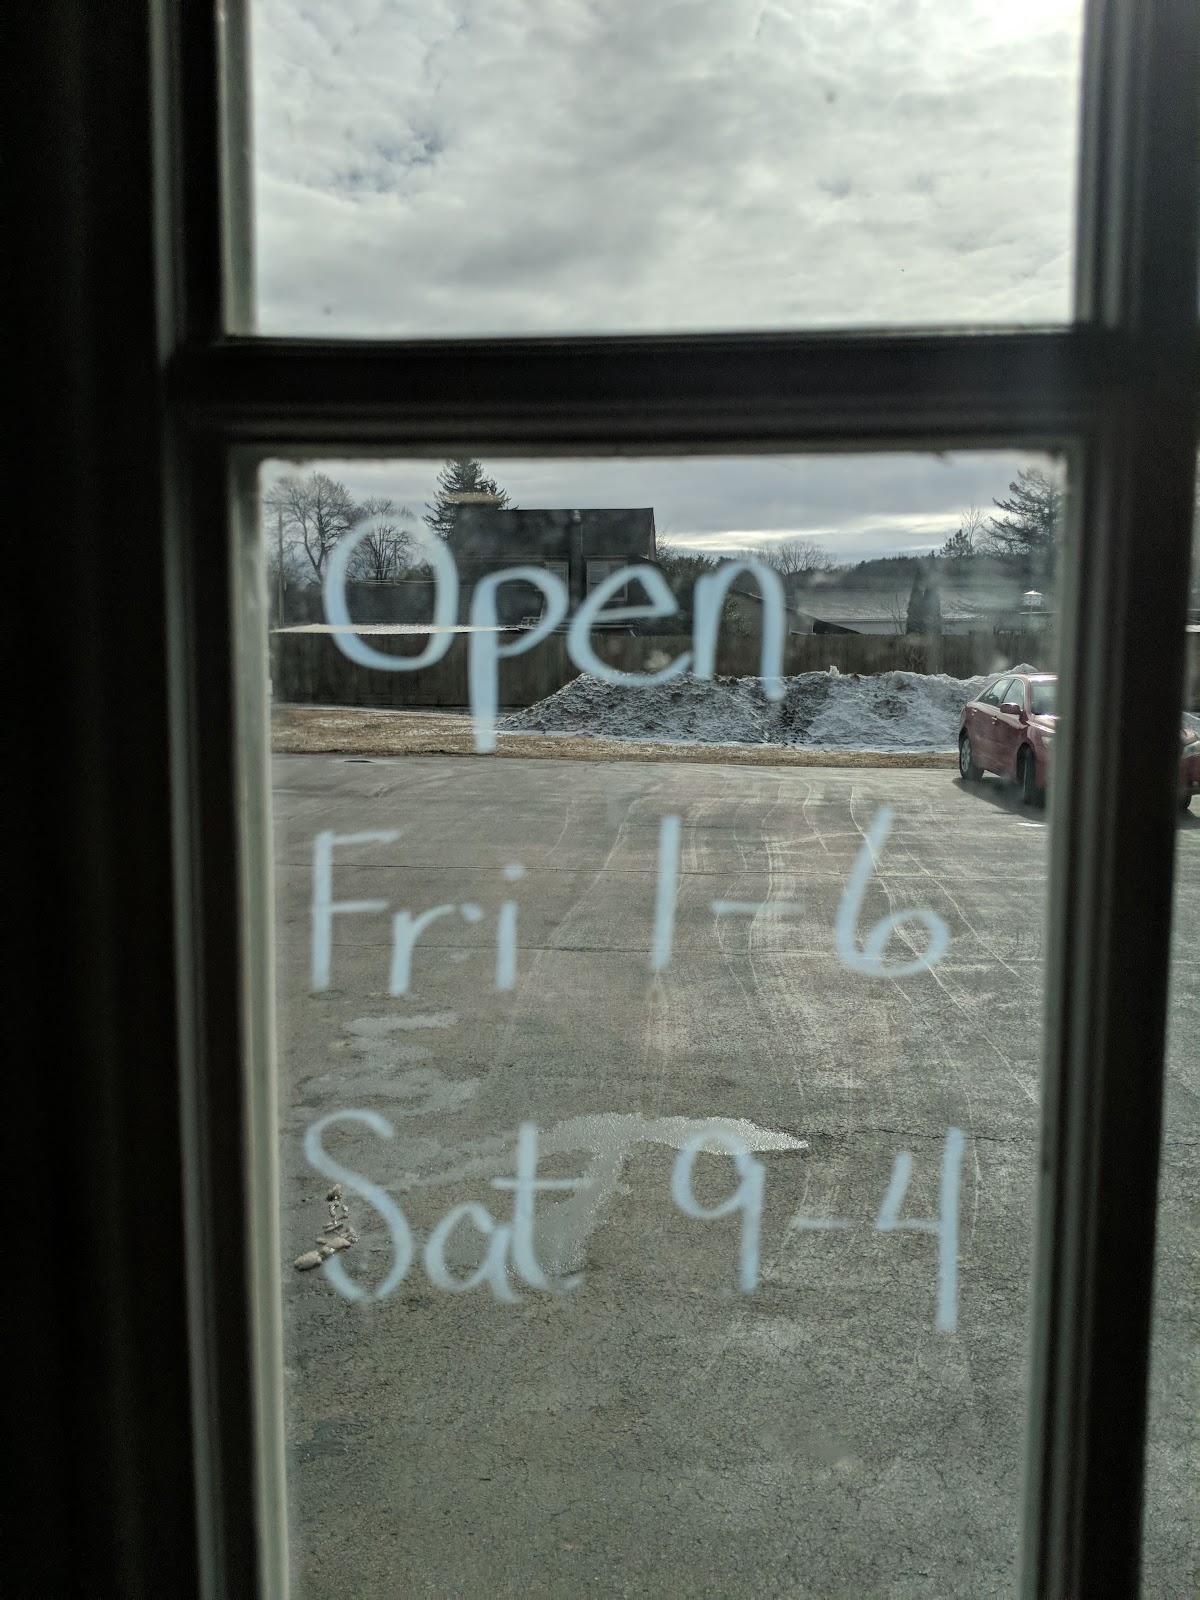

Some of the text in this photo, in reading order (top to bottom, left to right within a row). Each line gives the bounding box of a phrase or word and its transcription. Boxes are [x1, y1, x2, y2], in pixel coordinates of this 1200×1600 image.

[323, 514, 786, 754] Open
[311, 829, 525, 997] Fri
[304, 1108, 965, 1334] Sat 9-4
